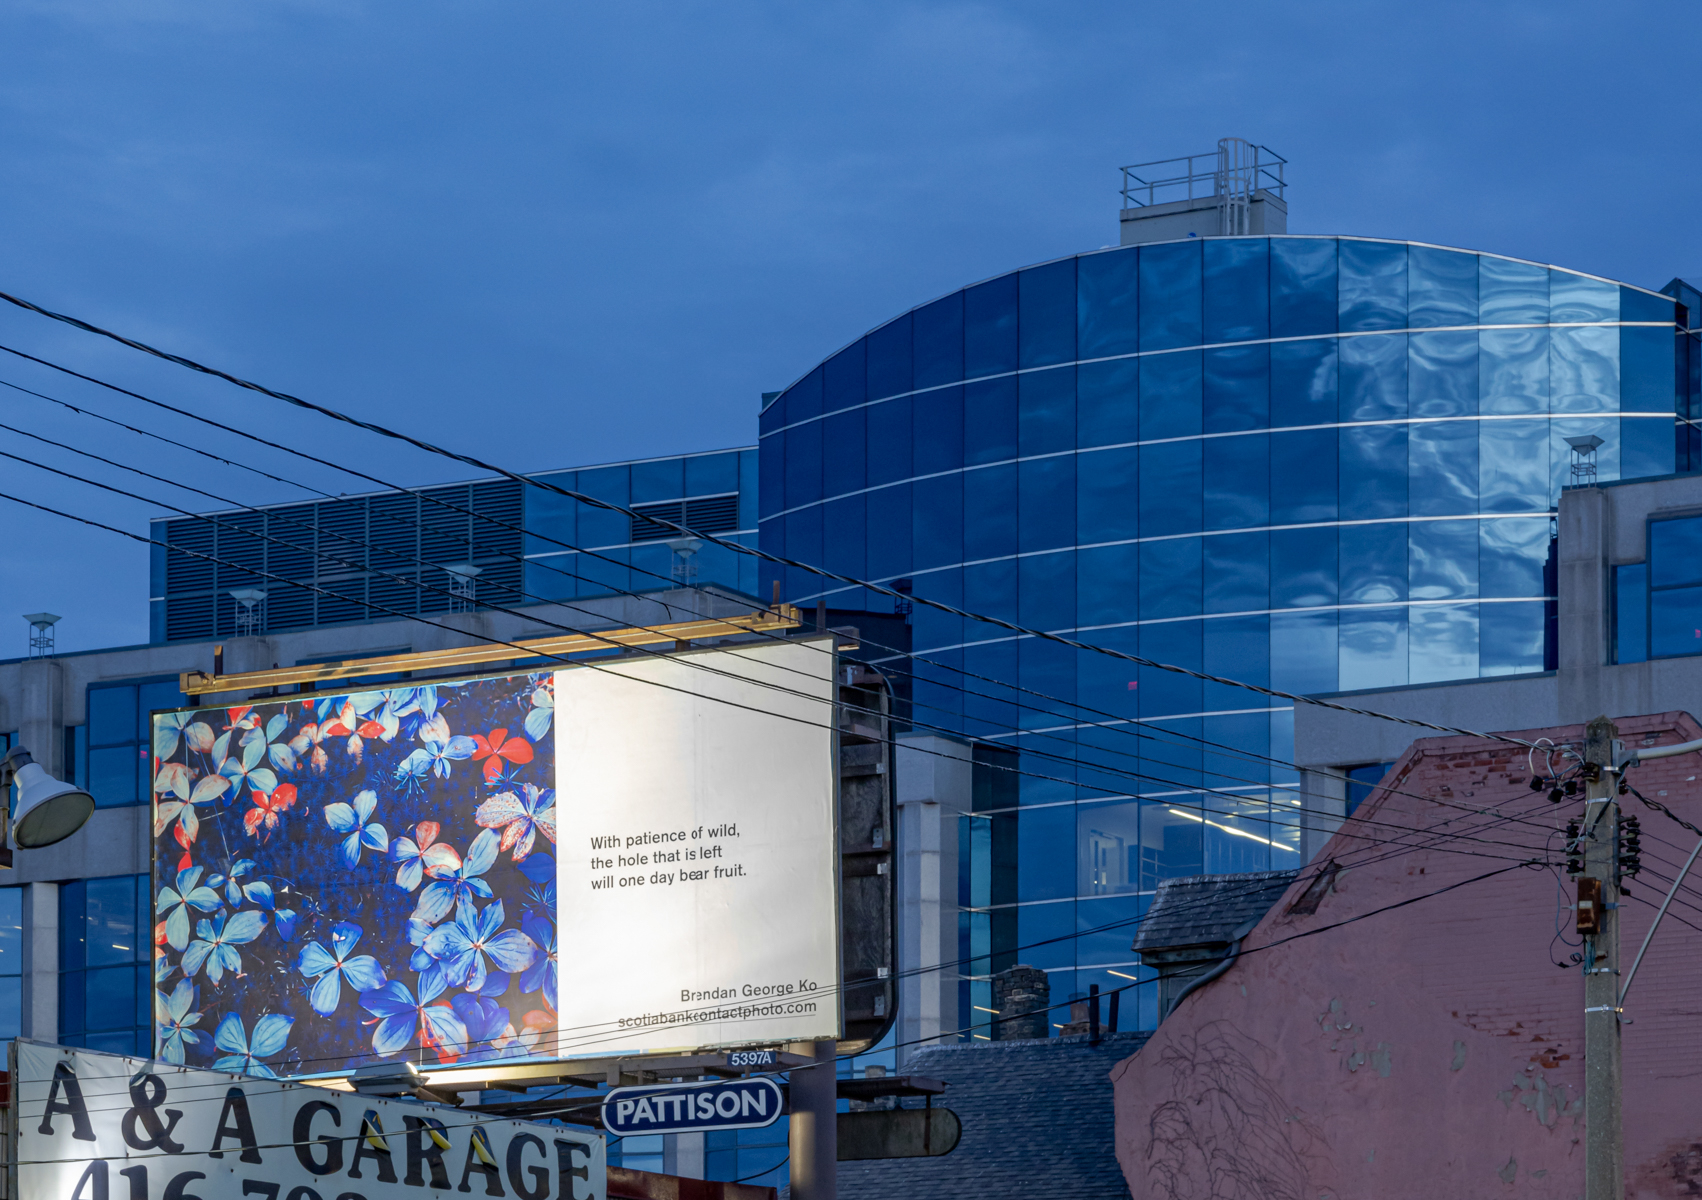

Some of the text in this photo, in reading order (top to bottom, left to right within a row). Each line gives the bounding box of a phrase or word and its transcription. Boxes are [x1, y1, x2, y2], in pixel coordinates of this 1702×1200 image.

[591, 823, 740, 850] With patience of wild,
[591, 845, 722, 870] the hole that is left
[591, 864, 747, 890] will one day bear fruit.
[681, 979, 817, 1002] Brendan George Ko
[618, 1002, 817, 1029] scotiabankcontactphoto.com
[731, 1051, 772, 1066] 5397A
[38, 1060, 97, 1142] A
[121, 1073, 185, 1154] &
[209, 1087, 263, 1165] A
[617, 1088, 767, 1126] PATTISON
